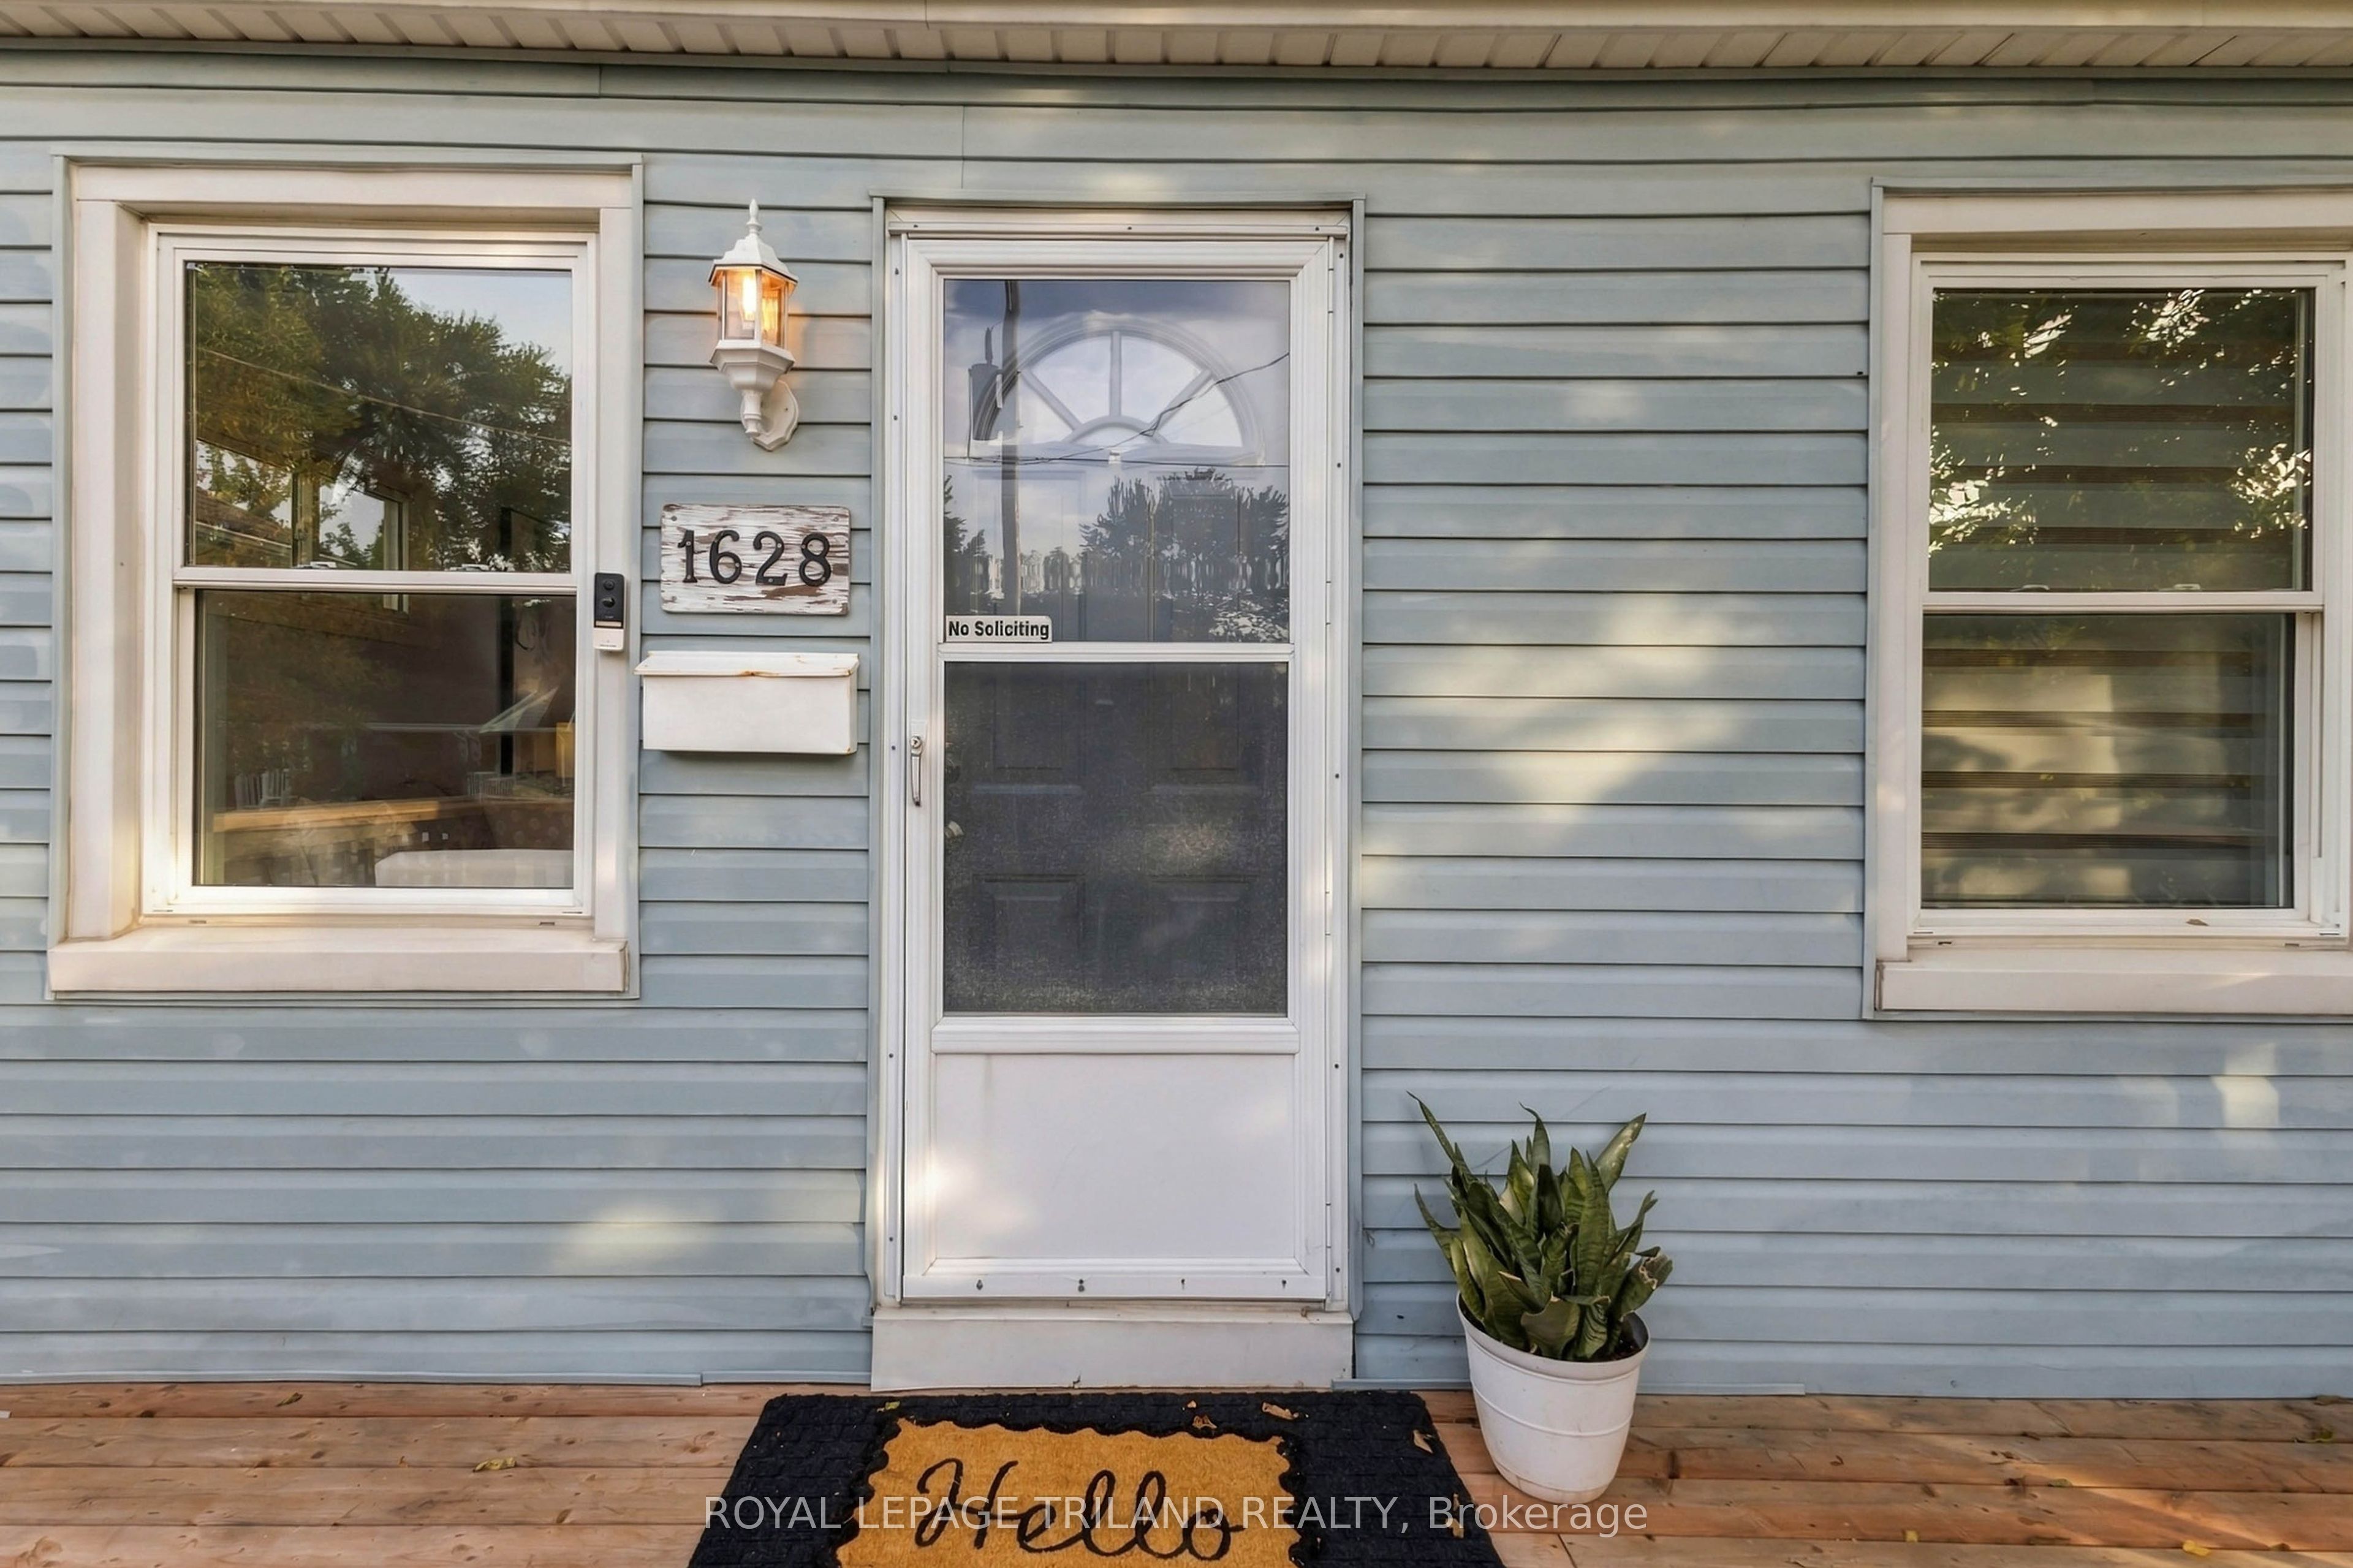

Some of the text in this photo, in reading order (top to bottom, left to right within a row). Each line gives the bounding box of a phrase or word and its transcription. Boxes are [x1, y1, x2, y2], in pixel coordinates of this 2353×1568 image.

[677, 529, 832, 586] 1628
[949, 620, 1049, 640] No Soliciting
[914, 1458, 1246, 1561] Hello
